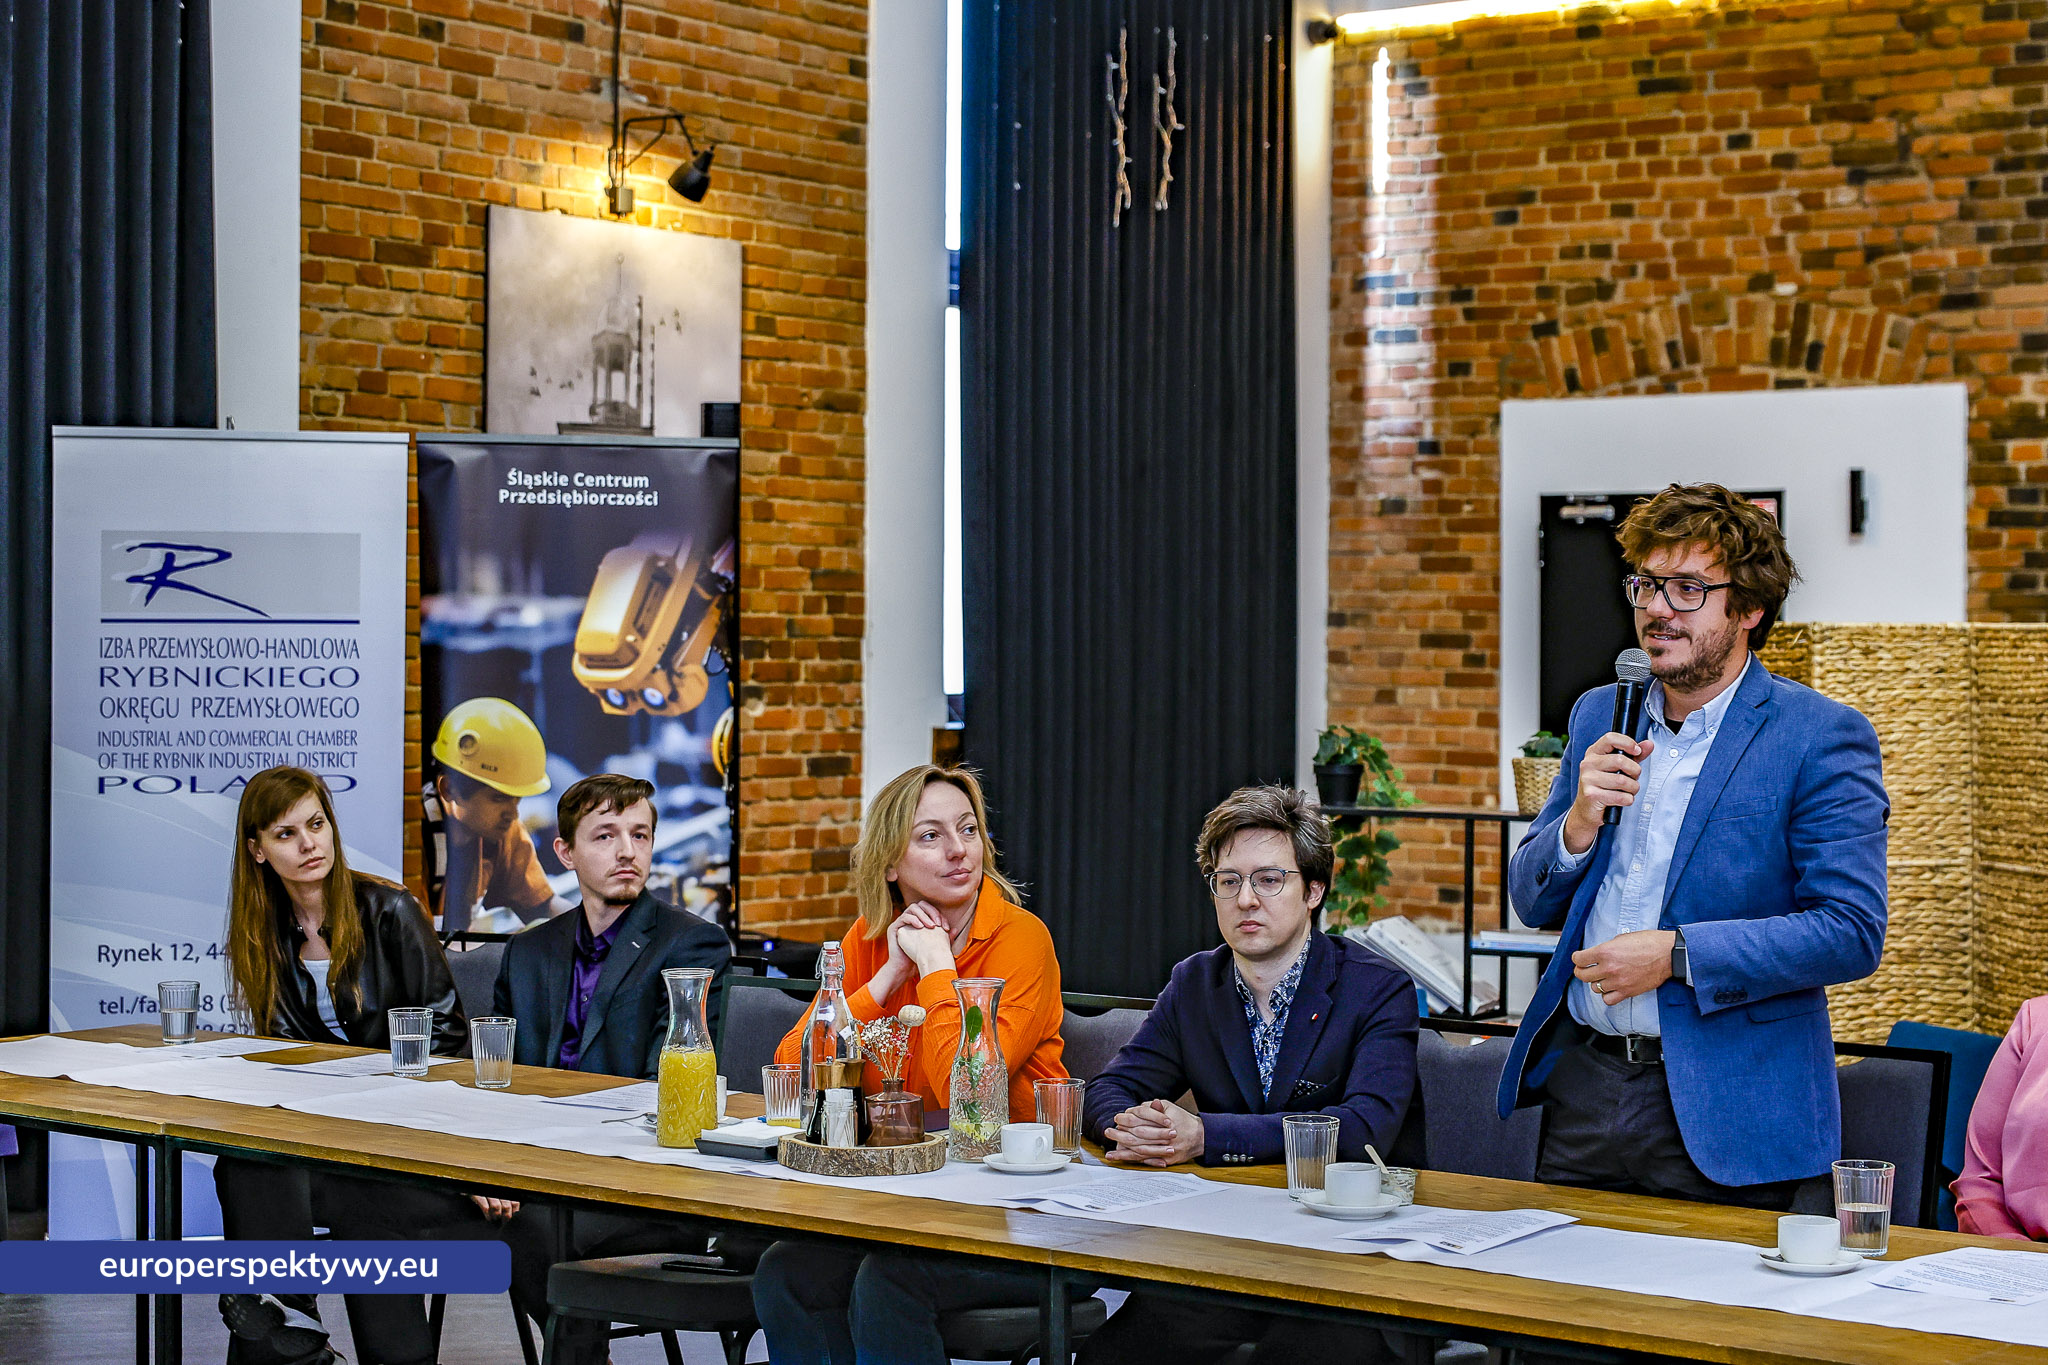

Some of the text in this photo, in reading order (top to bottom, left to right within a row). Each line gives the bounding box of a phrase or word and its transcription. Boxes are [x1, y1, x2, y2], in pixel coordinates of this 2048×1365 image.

[507, 468, 650, 489] Śląskie Centrum
[498, 488, 659, 508] Przedsiębiorczości
[100, 637, 360, 660] IZBA PRZEMYSŁOWO-HANDLOWA
[100, 666, 360, 688] RYBNICKIEGO
[100, 696, 360, 724] OKRĘGU PRZEMYSŁOWEGO
[98, 729, 358, 748] INDUSTRIAL AND COMMERCIAL CHAMBER
[98, 751, 358, 770] OF THE RYBNIK INDUSTRIAL DISTRICT
[98, 774, 358, 795] POLAD
[98, 943, 163, 967] Rynek
[170, 943, 200, 964] 12,
